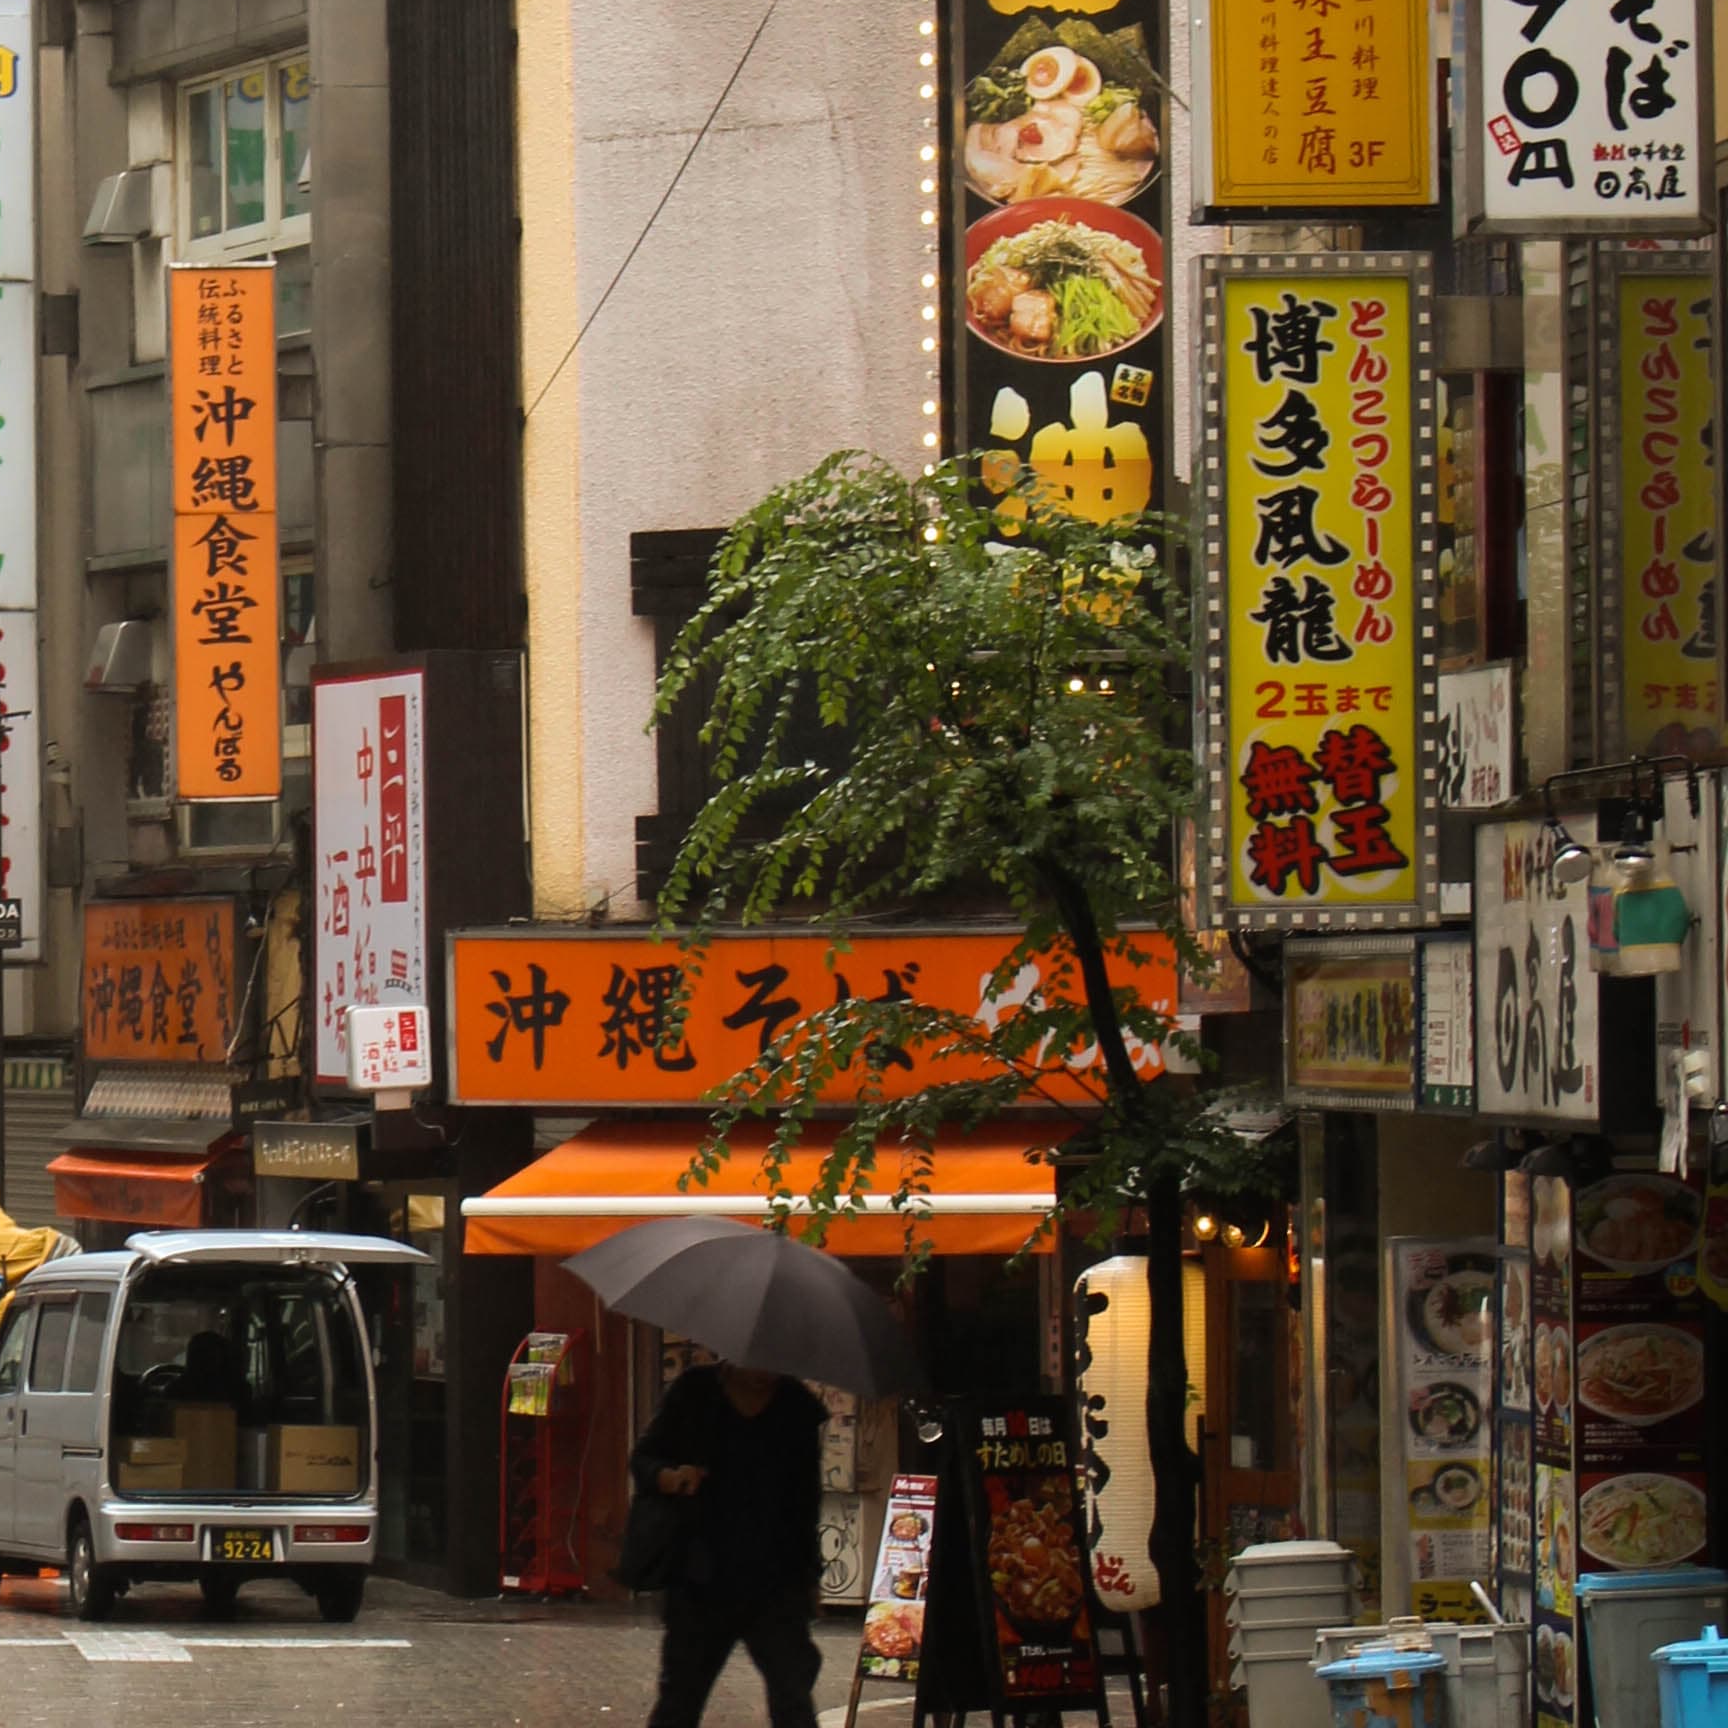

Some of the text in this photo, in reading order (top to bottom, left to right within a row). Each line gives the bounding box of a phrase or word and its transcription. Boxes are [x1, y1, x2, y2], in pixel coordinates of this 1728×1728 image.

[1349, 140, 1386, 168] 3F
[1594, 165, 1687, 201] 日高屋
[198, 277, 221, 376] 伝統料理
[222, 276, 247, 376] ふるさと
[1244, 294, 1352, 664] 博多風龍
[1349, 298, 1394, 644] とんこつらーめん
[190, 384, 259, 783] 沖縄食堂 やんばる
[1254, 681, 1394, 719] 2玉まで
[1240, 742, 1322, 897] 無料
[1314, 724, 1409, 874] 替玉
[975, 1439, 1069, 1470] すためしの日
